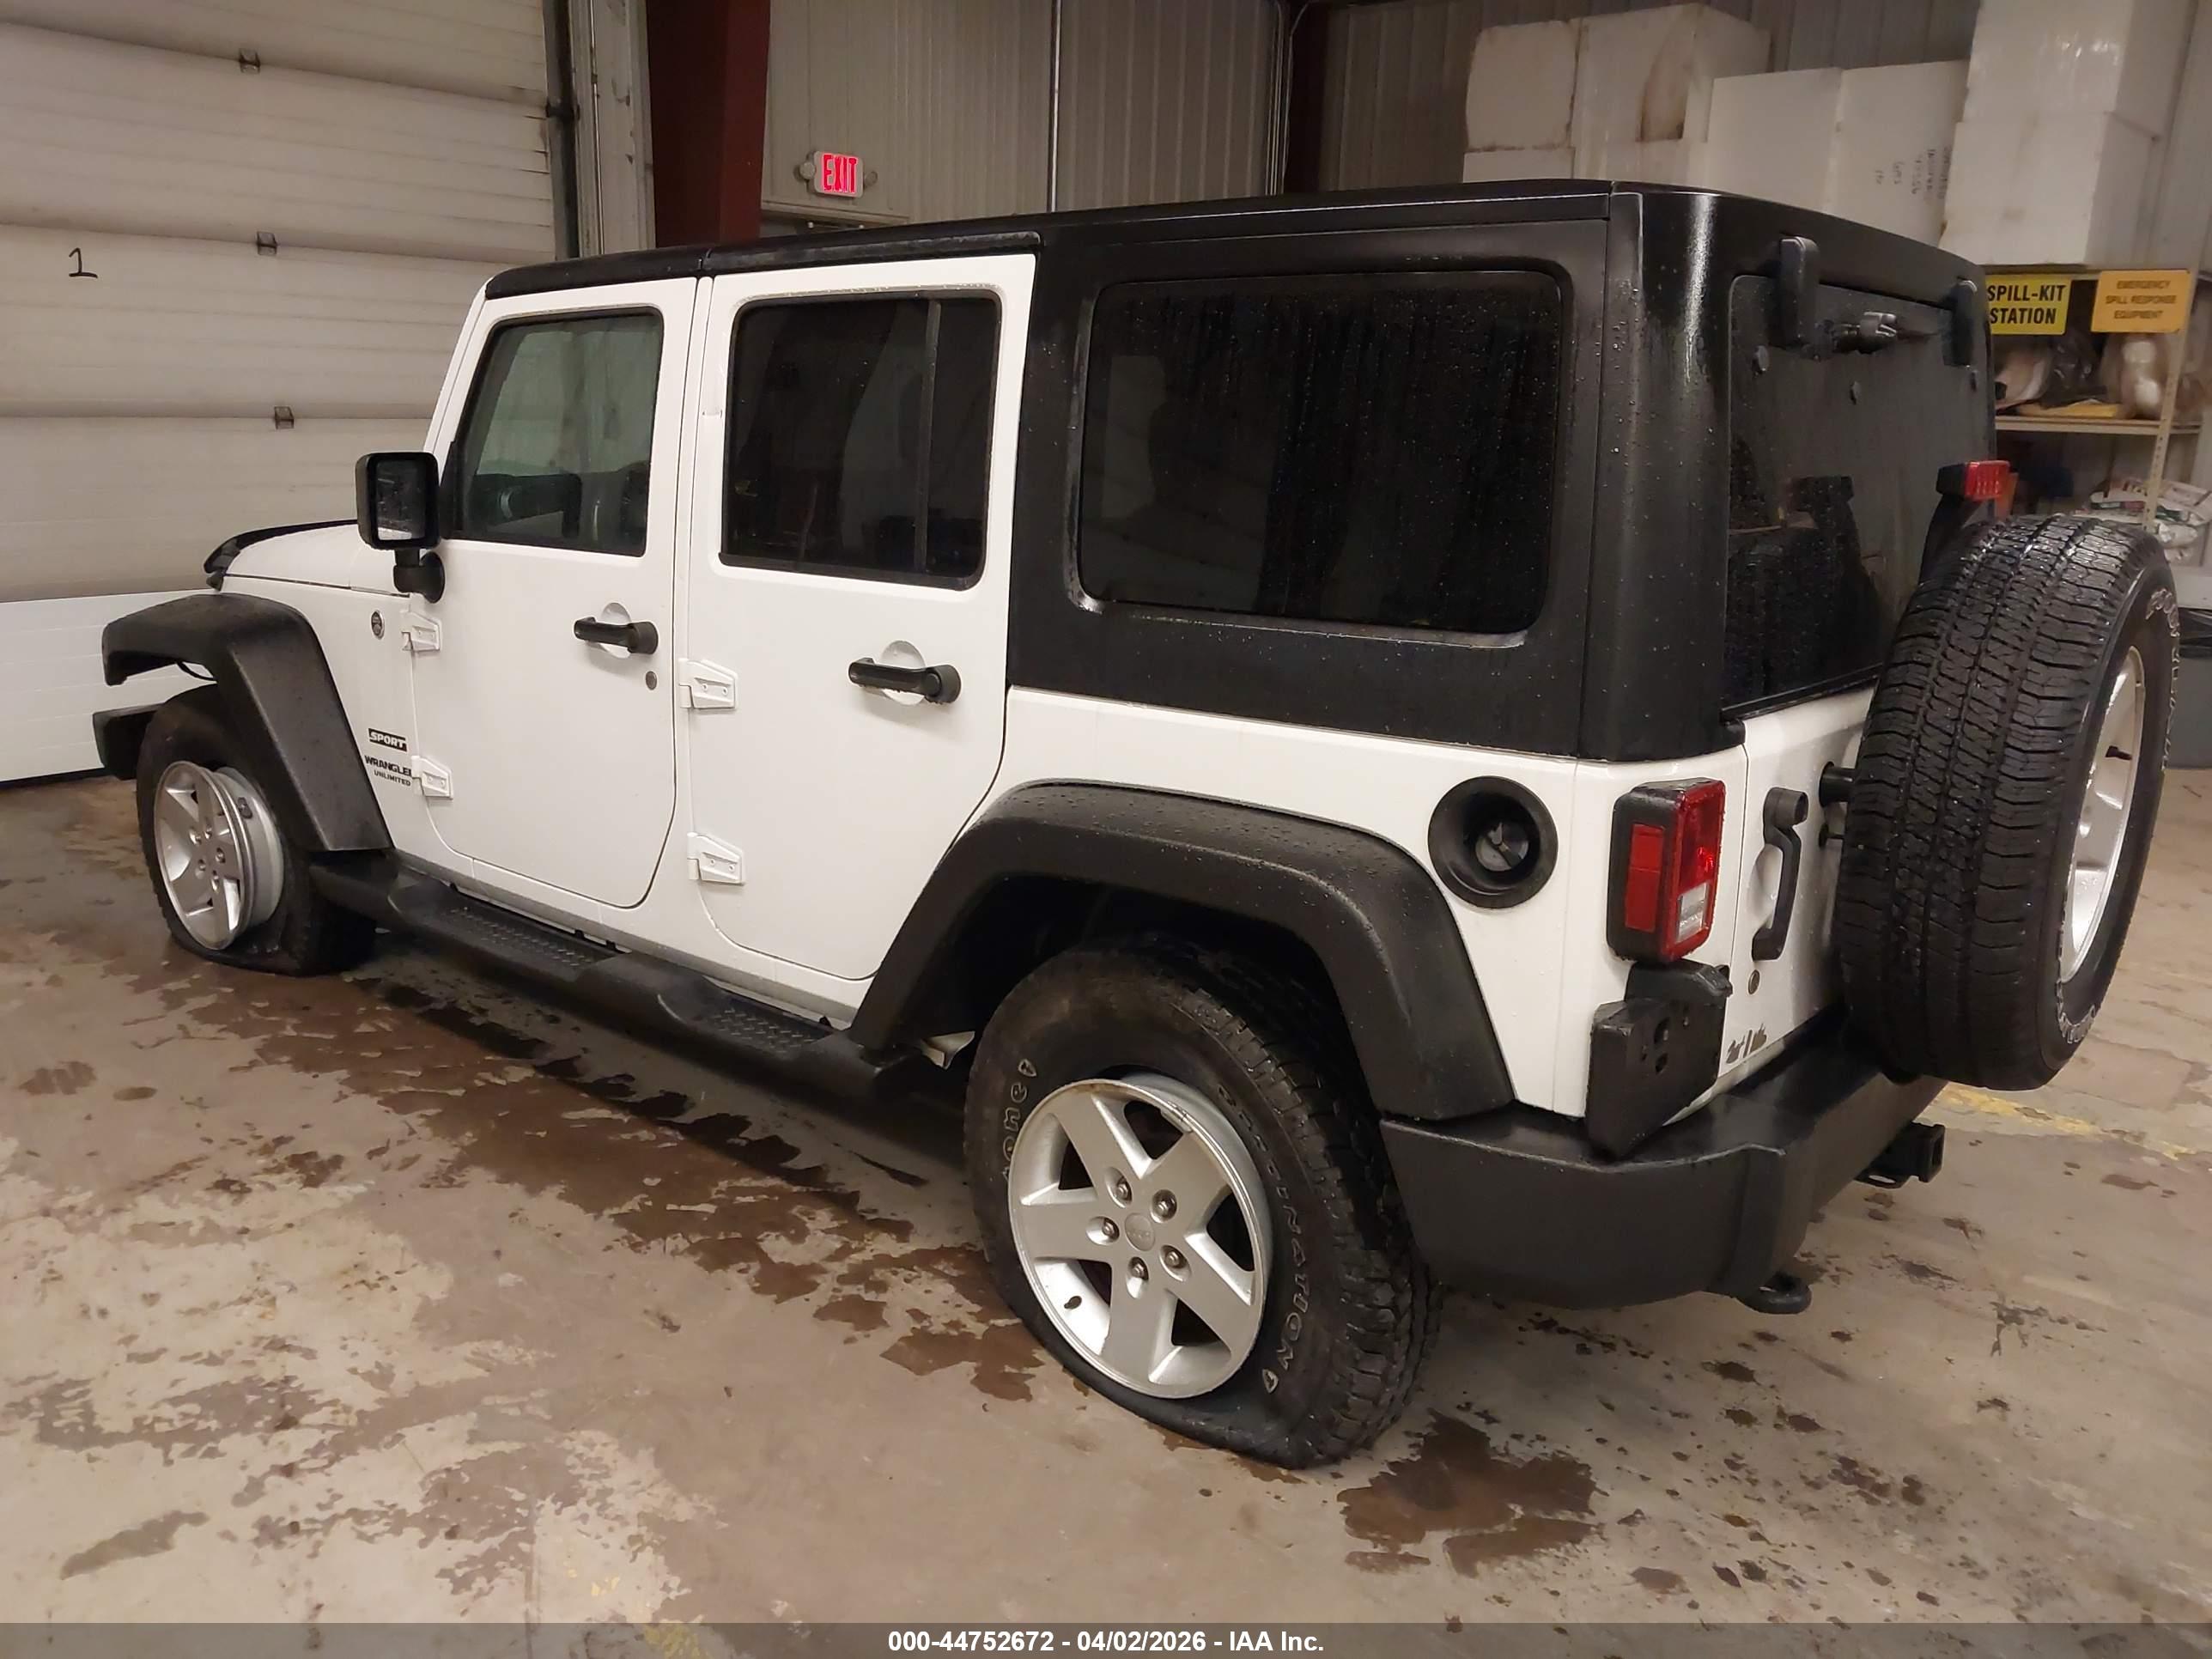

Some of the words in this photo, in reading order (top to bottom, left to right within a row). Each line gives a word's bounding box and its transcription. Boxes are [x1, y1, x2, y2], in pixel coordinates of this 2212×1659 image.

[823, 154, 857, 193] EXIT
[69, 247, 98, 278] 1
[1987, 284, 2066, 301] SPILL-KIT
[2105, 295, 2128, 304] SPILL
[1990, 307, 2057, 324] STATION
[369, 730, 406, 749] SPORT
[374, 769, 411, 787] UNLIMITED
